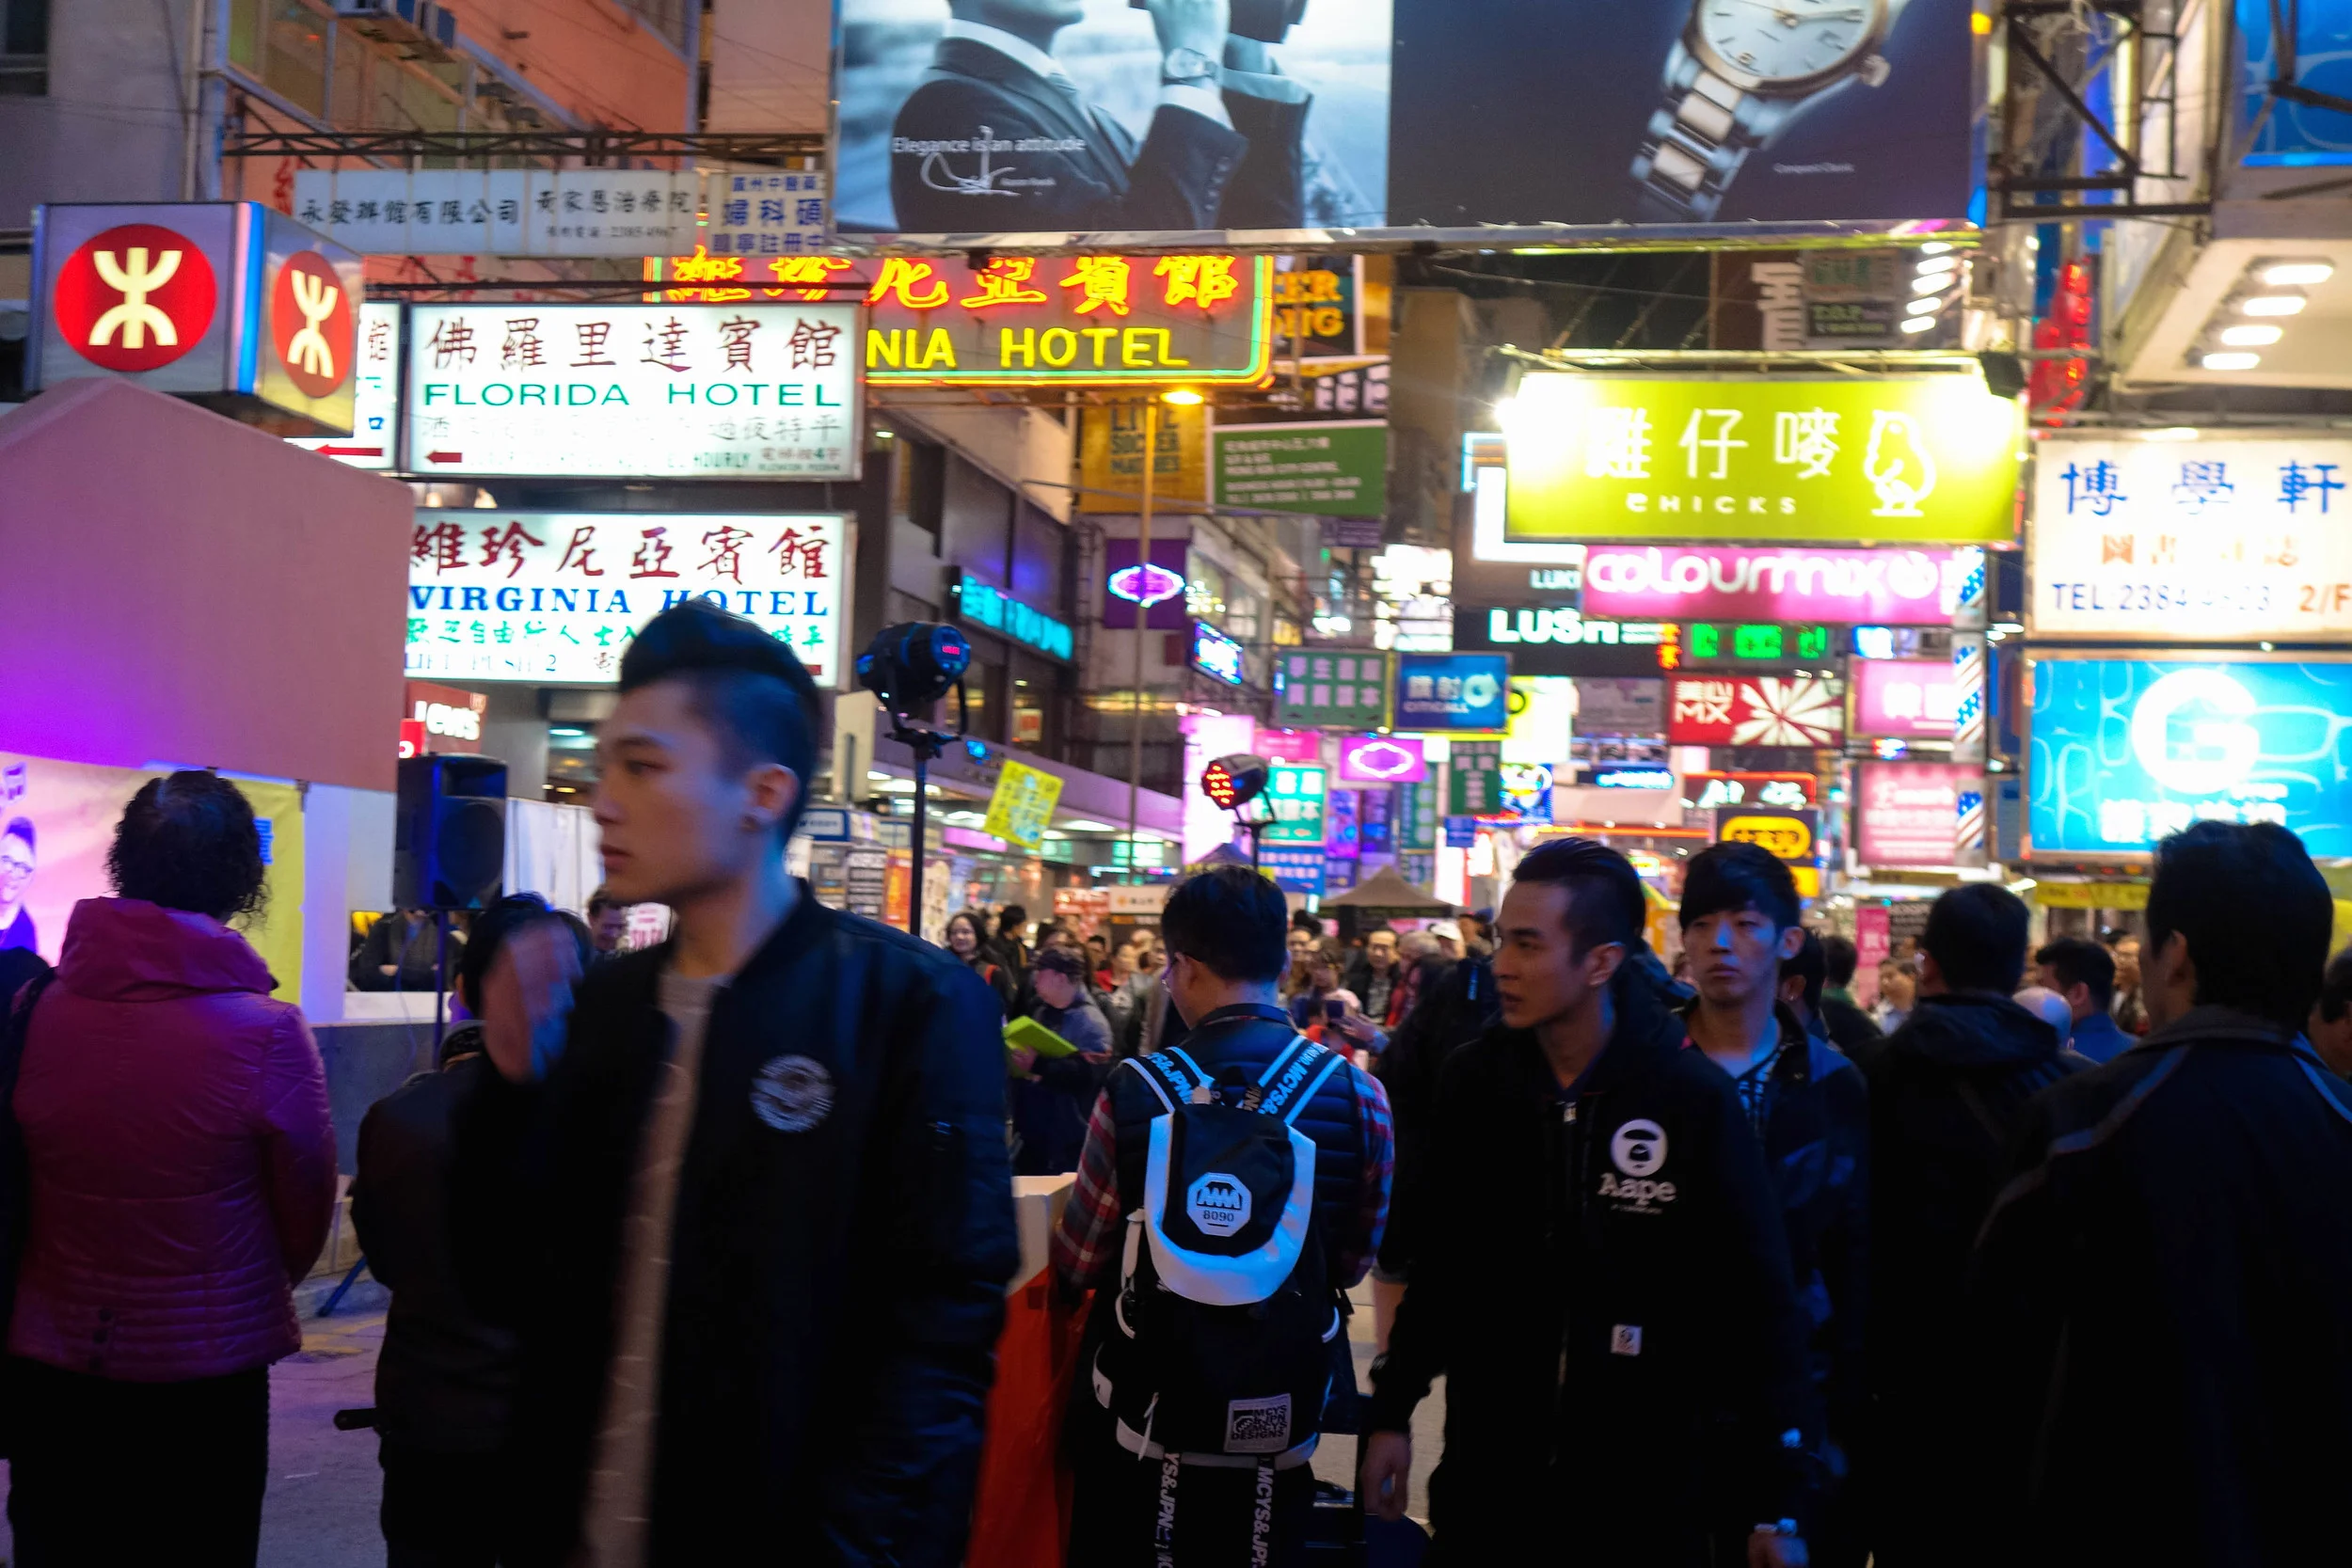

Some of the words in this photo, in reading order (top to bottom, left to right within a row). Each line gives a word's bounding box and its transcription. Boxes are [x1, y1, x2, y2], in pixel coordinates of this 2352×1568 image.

[425, 316, 842, 372] 佛羅里達賓館
[1001, 326, 1190, 368] HOTEL
[424, 383, 629, 406] FLORIDA
[669, 383, 841, 406] HOTEL
[2059, 459, 2346, 515] 博學軒
[1626, 493, 1797, 514] CHICKS
[409, 585, 632, 614] VIRGINIA
[1674, 702, 1733, 726] MX
[1597, 1172, 1677, 1206] Aape
[1203, 1210, 1234, 1222] 8090
